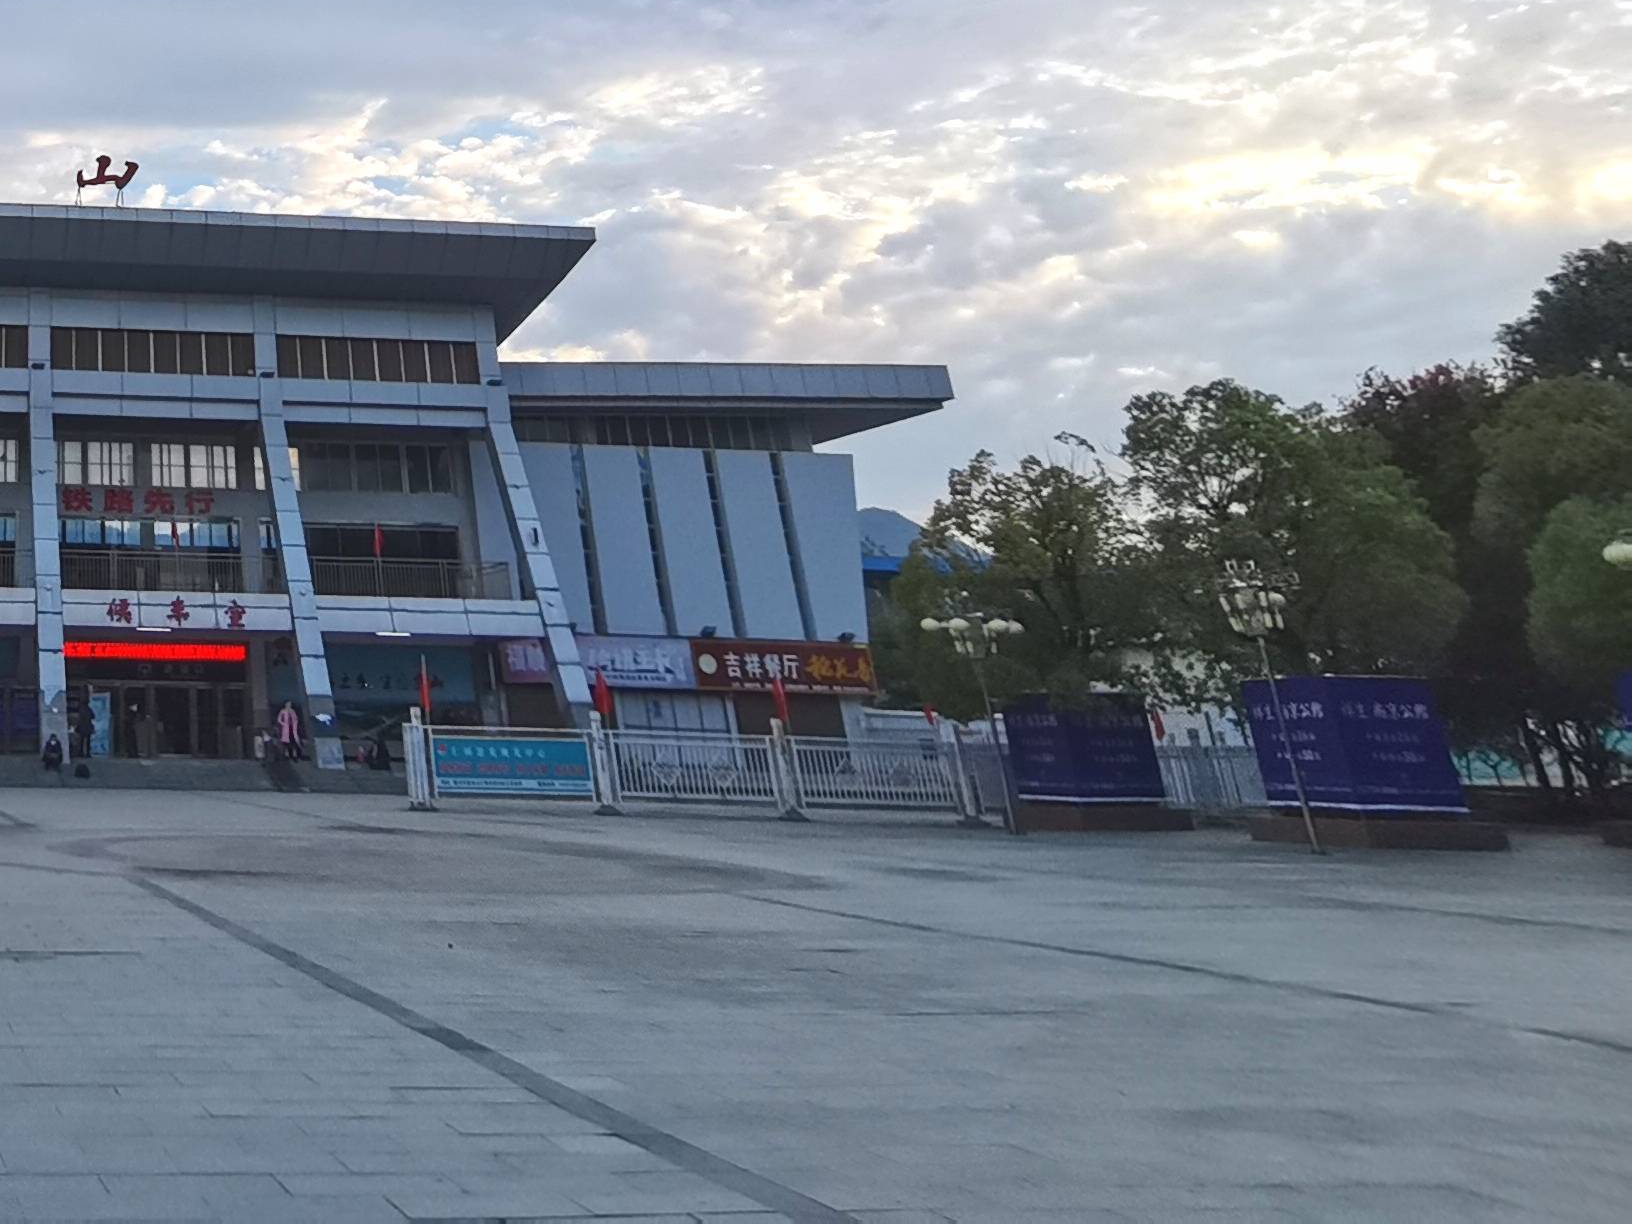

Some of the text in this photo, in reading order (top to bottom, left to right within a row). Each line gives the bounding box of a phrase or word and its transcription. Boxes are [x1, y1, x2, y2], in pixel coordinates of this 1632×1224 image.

[62, 487, 216, 514] 铁路先行
[723, 651, 801, 680] 吉祥餐厅
